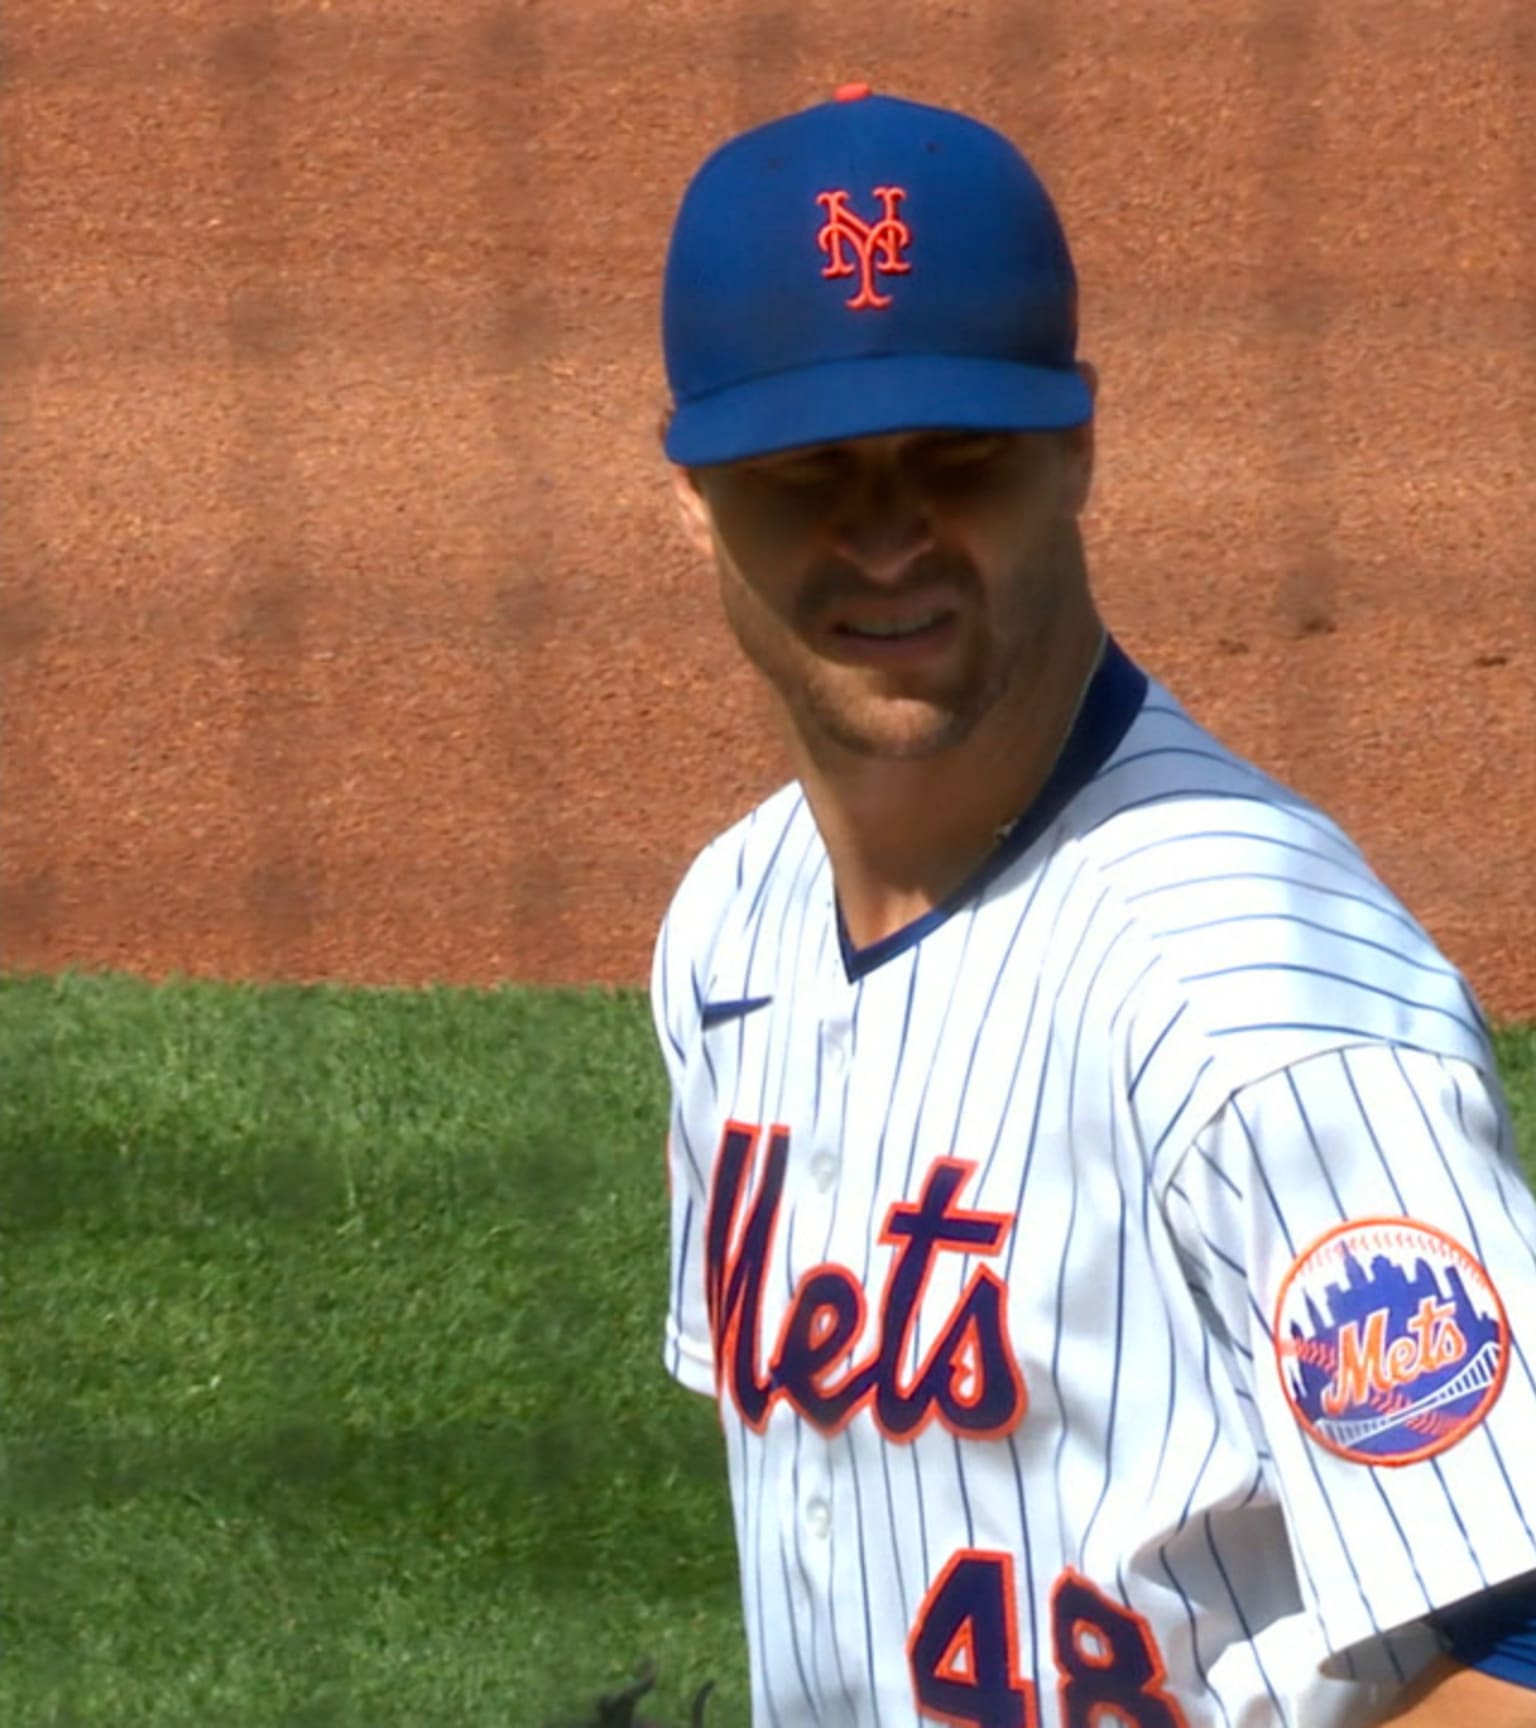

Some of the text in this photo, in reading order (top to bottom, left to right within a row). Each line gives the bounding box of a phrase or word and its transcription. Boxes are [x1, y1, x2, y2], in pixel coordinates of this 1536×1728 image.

[816, 185, 912, 311] NY
[704, 1119, 1029, 1446] Mets
[1321, 1295, 1467, 1416] Mets
[905, 1547, 1191, 1728] 48
